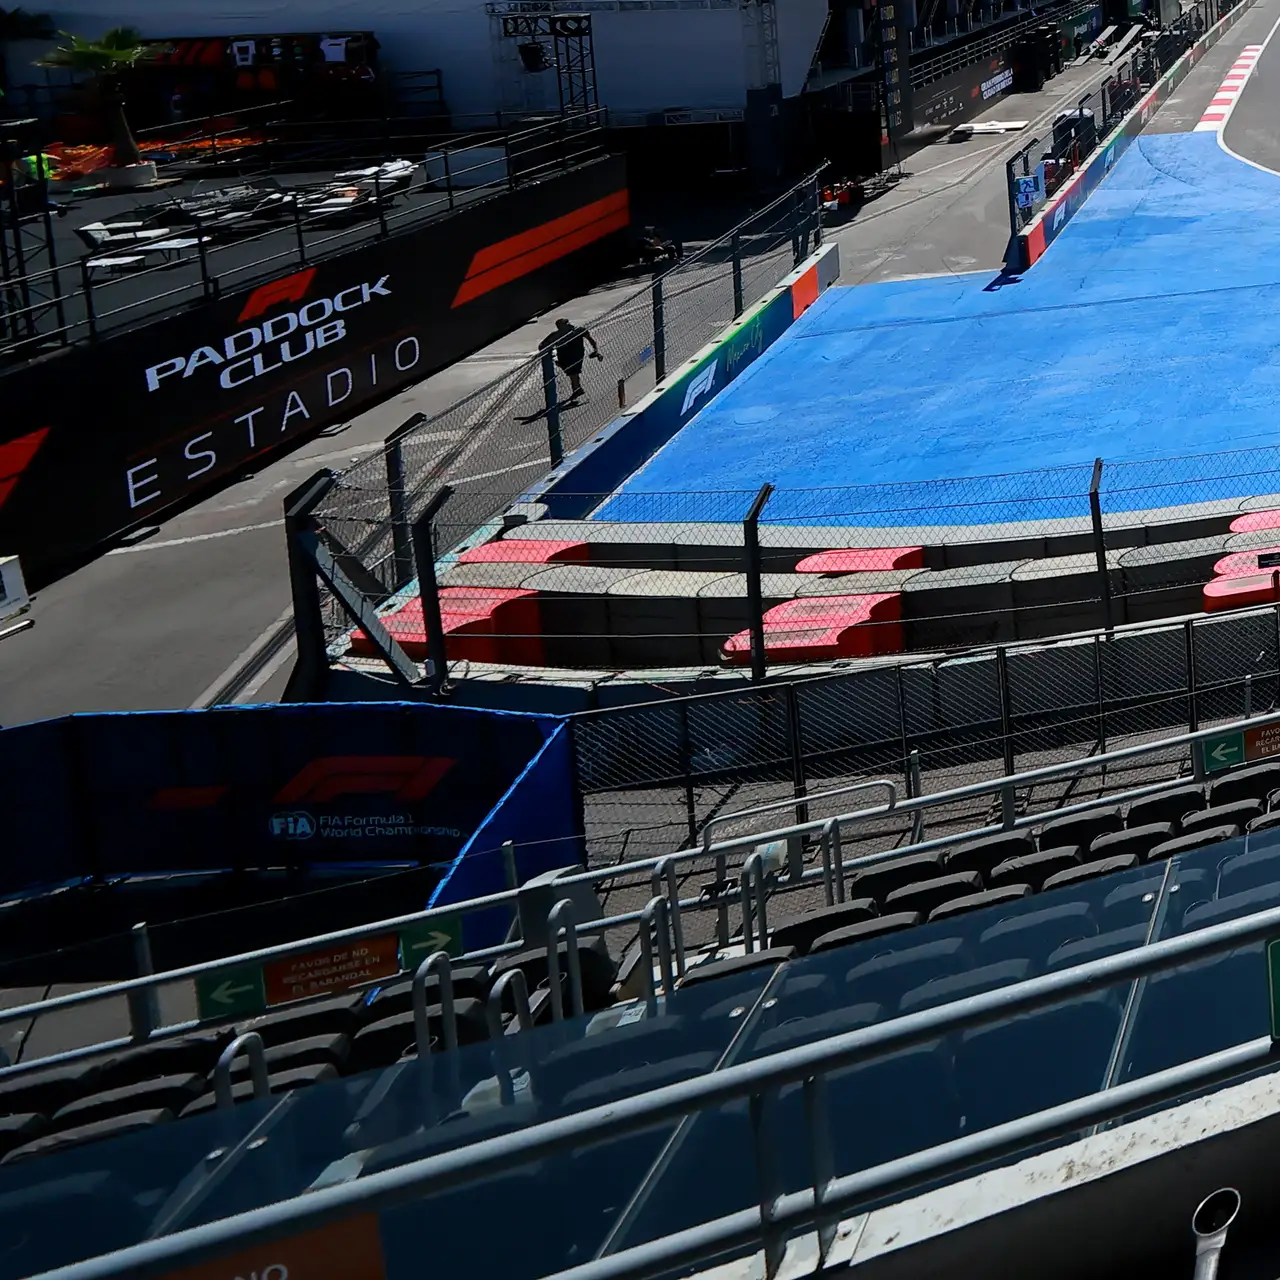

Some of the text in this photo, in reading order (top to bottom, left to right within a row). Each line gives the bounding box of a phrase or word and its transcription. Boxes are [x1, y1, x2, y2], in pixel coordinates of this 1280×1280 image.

[145, 274, 392, 392] PADDOCK
[219, 319, 347, 389] CLUB
[126, 336, 420, 509] ESTADIO
[1261, 745, 1270, 754] EL
[319, 815, 342, 827] FIA
[343, 813, 405, 827] Formula
[320, 824, 462, 839] World Championship
[291, 947, 370, 973] FAVOR DE NO
